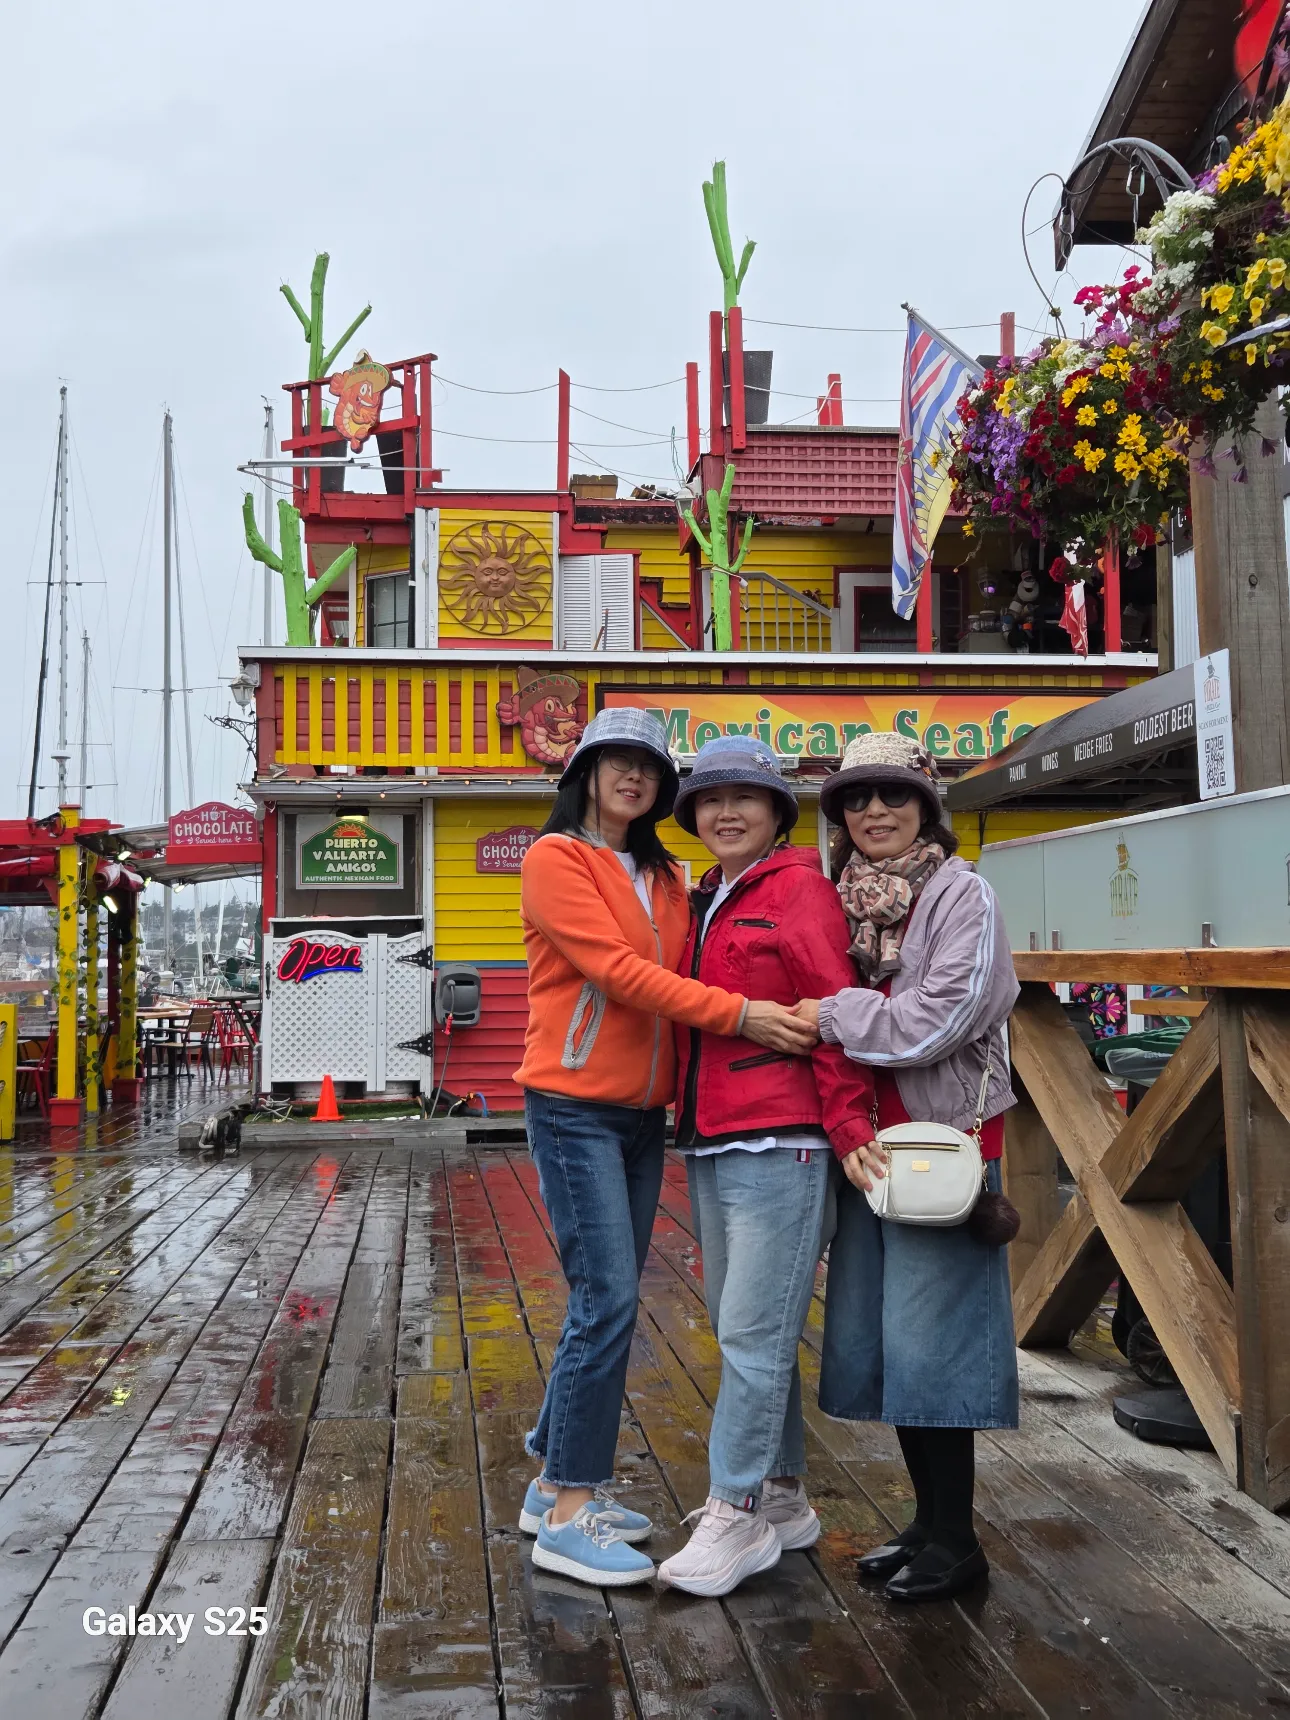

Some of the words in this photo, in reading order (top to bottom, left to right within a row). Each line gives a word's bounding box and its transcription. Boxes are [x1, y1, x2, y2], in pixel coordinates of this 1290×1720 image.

[1134, 711, 1170, 745] COLDEST
[1171, 703, 1194, 732] BEER
[1073, 740, 1095, 762] WEDGE
[1095, 733, 1113, 756] FRIES
[201, 810, 229, 822] HOT
[174, 821, 254, 837] CHOCOLATE
[195, 836, 217, 845] Served
[218, 836, 233, 844] here
[325, 838, 379, 849] PUERTO
[312, 850, 388, 861] VALLARTA
[325, 862, 377, 873] AMIGOS
[278, 938, 362, 984] Open
